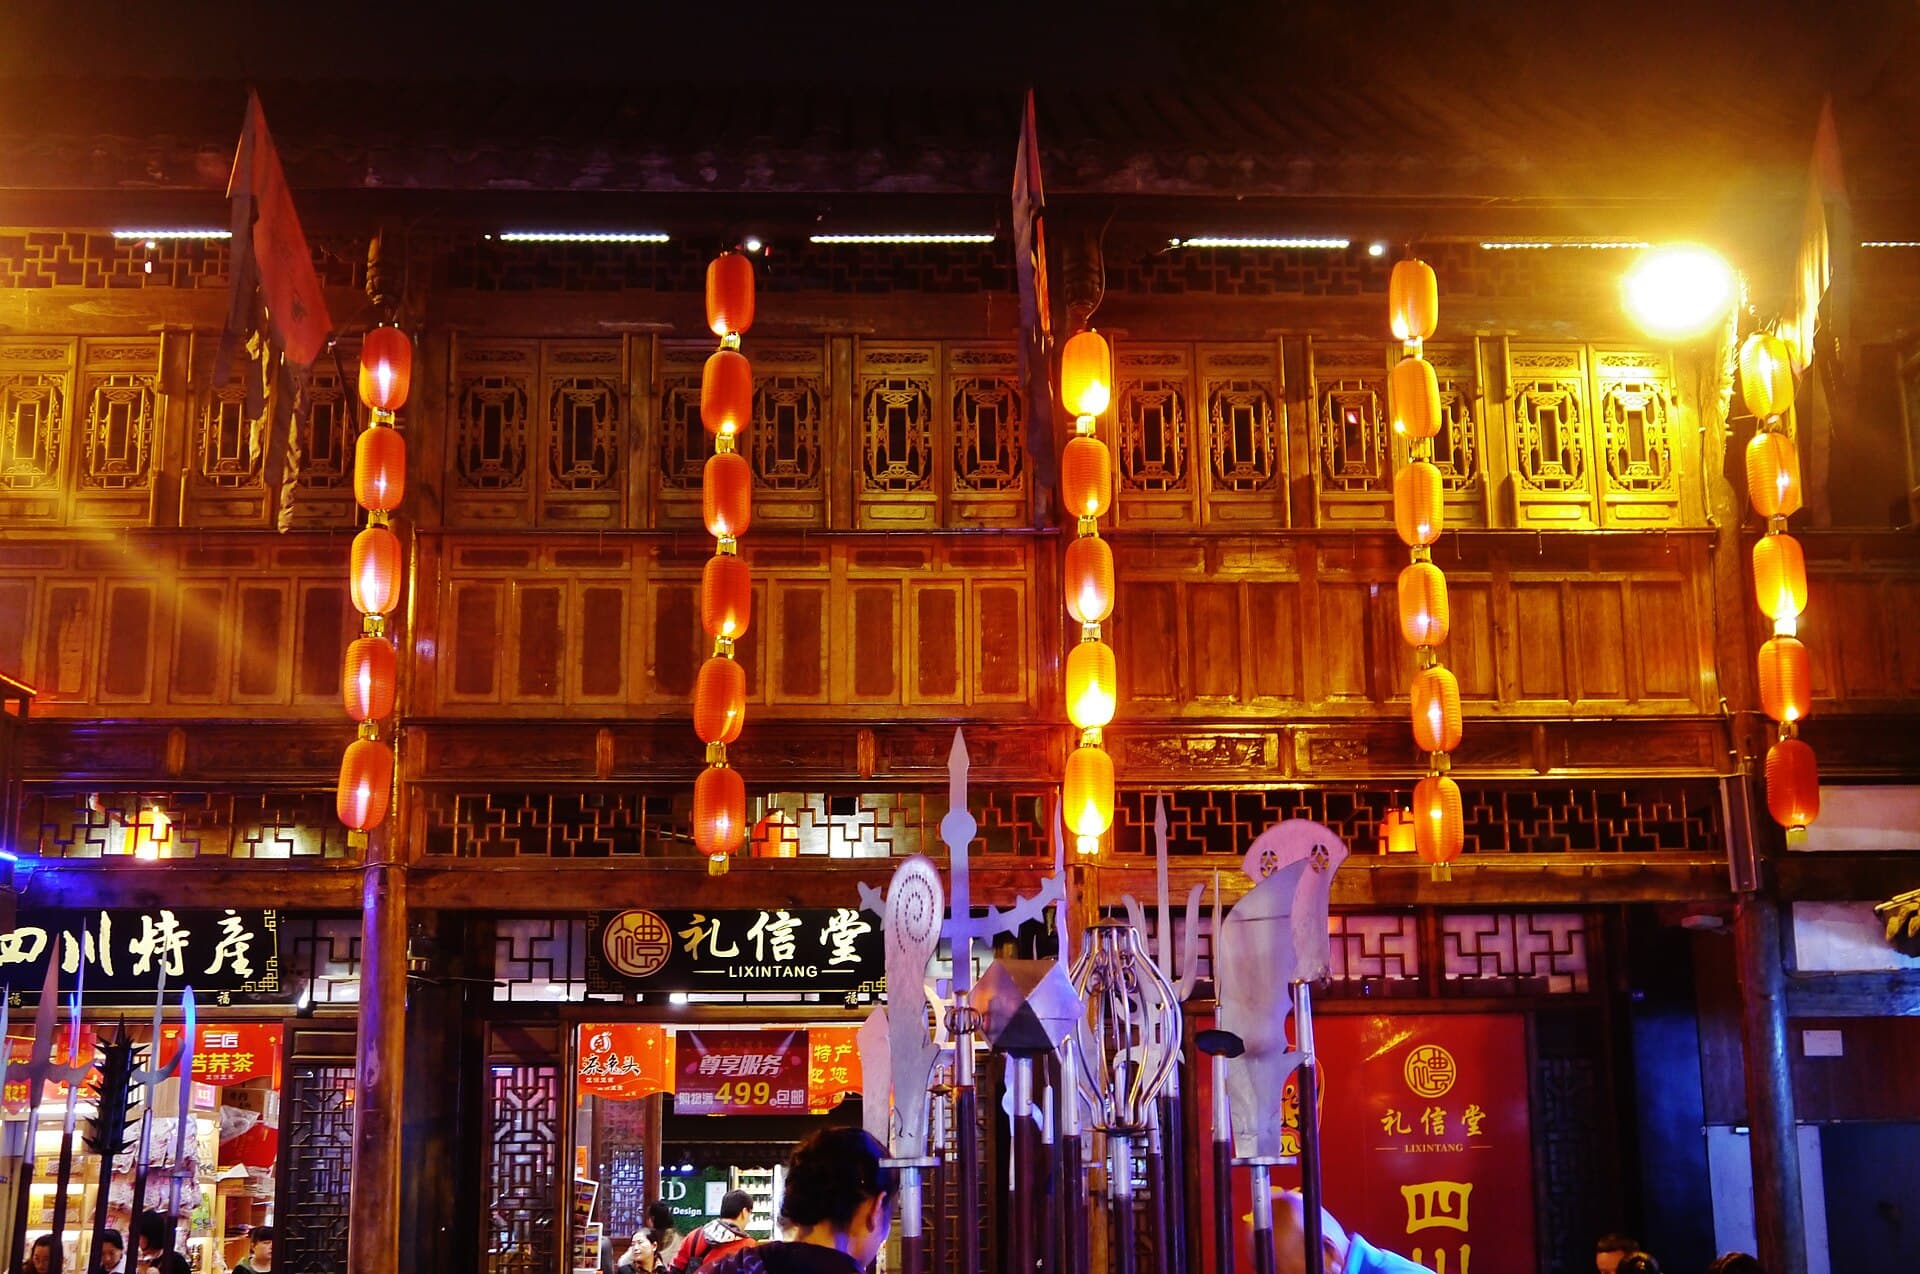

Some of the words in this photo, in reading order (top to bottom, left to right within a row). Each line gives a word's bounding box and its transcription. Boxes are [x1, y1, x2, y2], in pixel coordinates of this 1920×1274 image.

[677, 908, 872, 965] 礼信堂
[729, 965, 818, 978] LIXINTANG
[698, 1054, 784, 1076] 尊享服务
[1381, 1104, 1487, 1136] 礼信堂
[1404, 1143, 1464, 1153] LIXINTANG
[673, 1206, 702, 1217] Design
